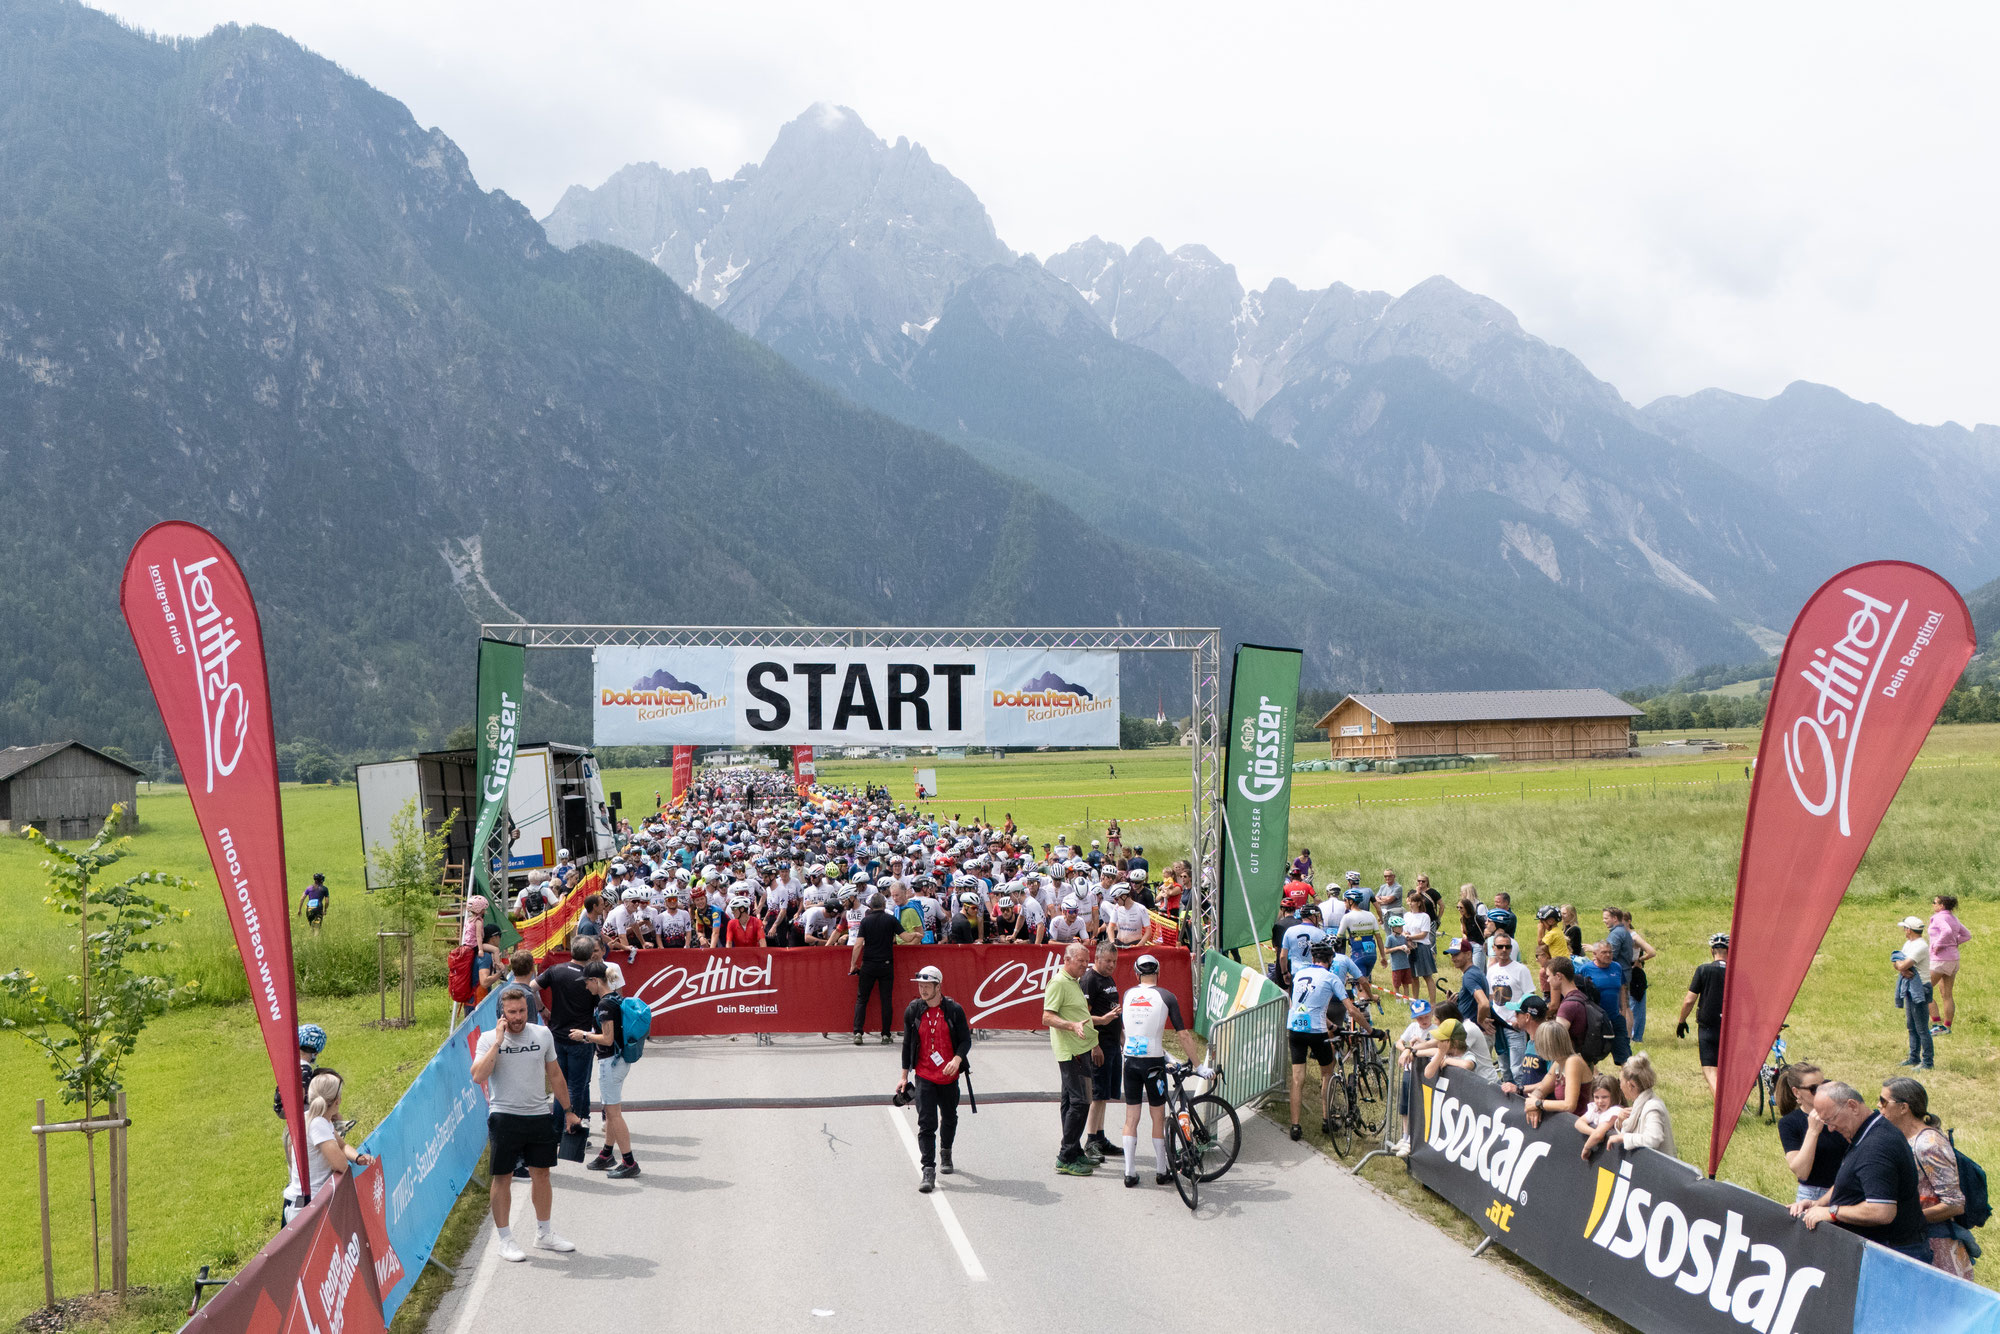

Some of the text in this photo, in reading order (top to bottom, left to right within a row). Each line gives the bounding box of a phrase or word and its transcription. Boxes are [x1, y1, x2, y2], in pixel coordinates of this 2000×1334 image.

[1882, 610, 1945, 698] Dein Bergtirol
[602, 688, 694, 706] Dolomiten
[638, 695, 728, 722] Radrundfahrt
[746, 661, 976, 731] START
[993, 689, 1080, 707] Dolomiten
[1027, 697, 1112, 723] Radrundfahrt
[1784, 588, 1893, 816] Osttirol
[1238, 696, 1285, 803] Gösser
[1251, 808, 1261, 874] GUT BESSER
[634, 953, 773, 1011] Osttirol
[717, 1004, 778, 1015] Dein Bergtirol
[1293, 1019, 1309, 1027] 438
[498, 1044, 541, 1054] HEAD
[1485, 1199, 1515, 1233] .at
[1593, 1160, 1826, 1334] isostar
